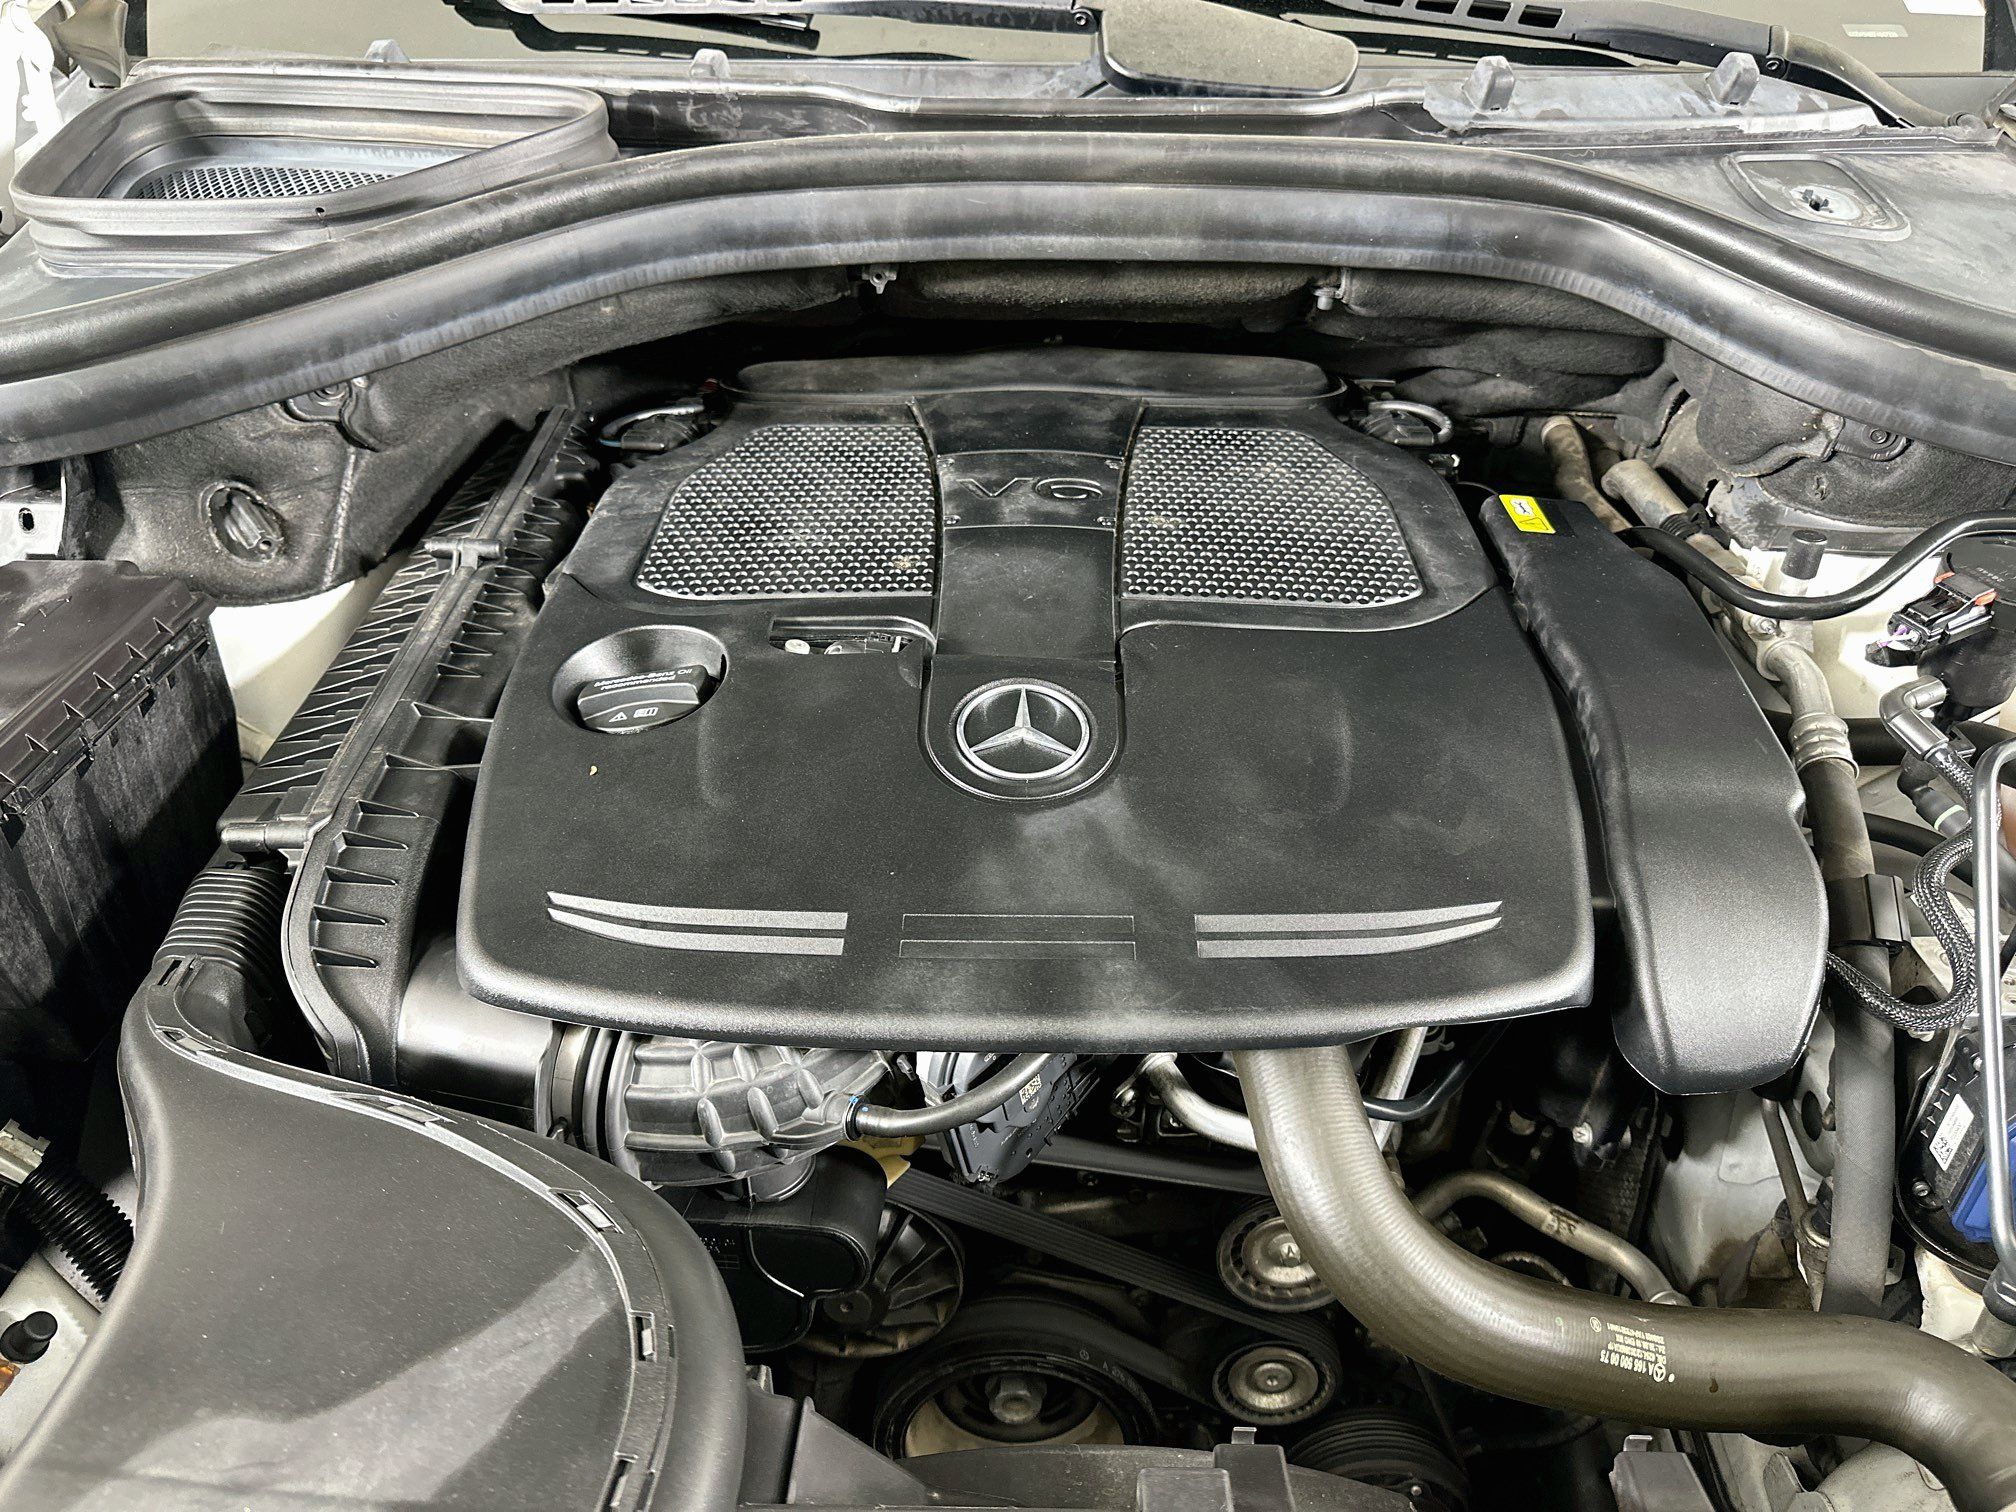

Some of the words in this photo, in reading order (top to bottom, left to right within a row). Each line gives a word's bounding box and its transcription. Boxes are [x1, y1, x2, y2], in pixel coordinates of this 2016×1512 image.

[955, 477, 1103, 501] V6
[594, 670, 675, 687] Mercedes-Benz
[600, 675, 676, 690] recommended
[1648, 1362, 1655, 1376] A
